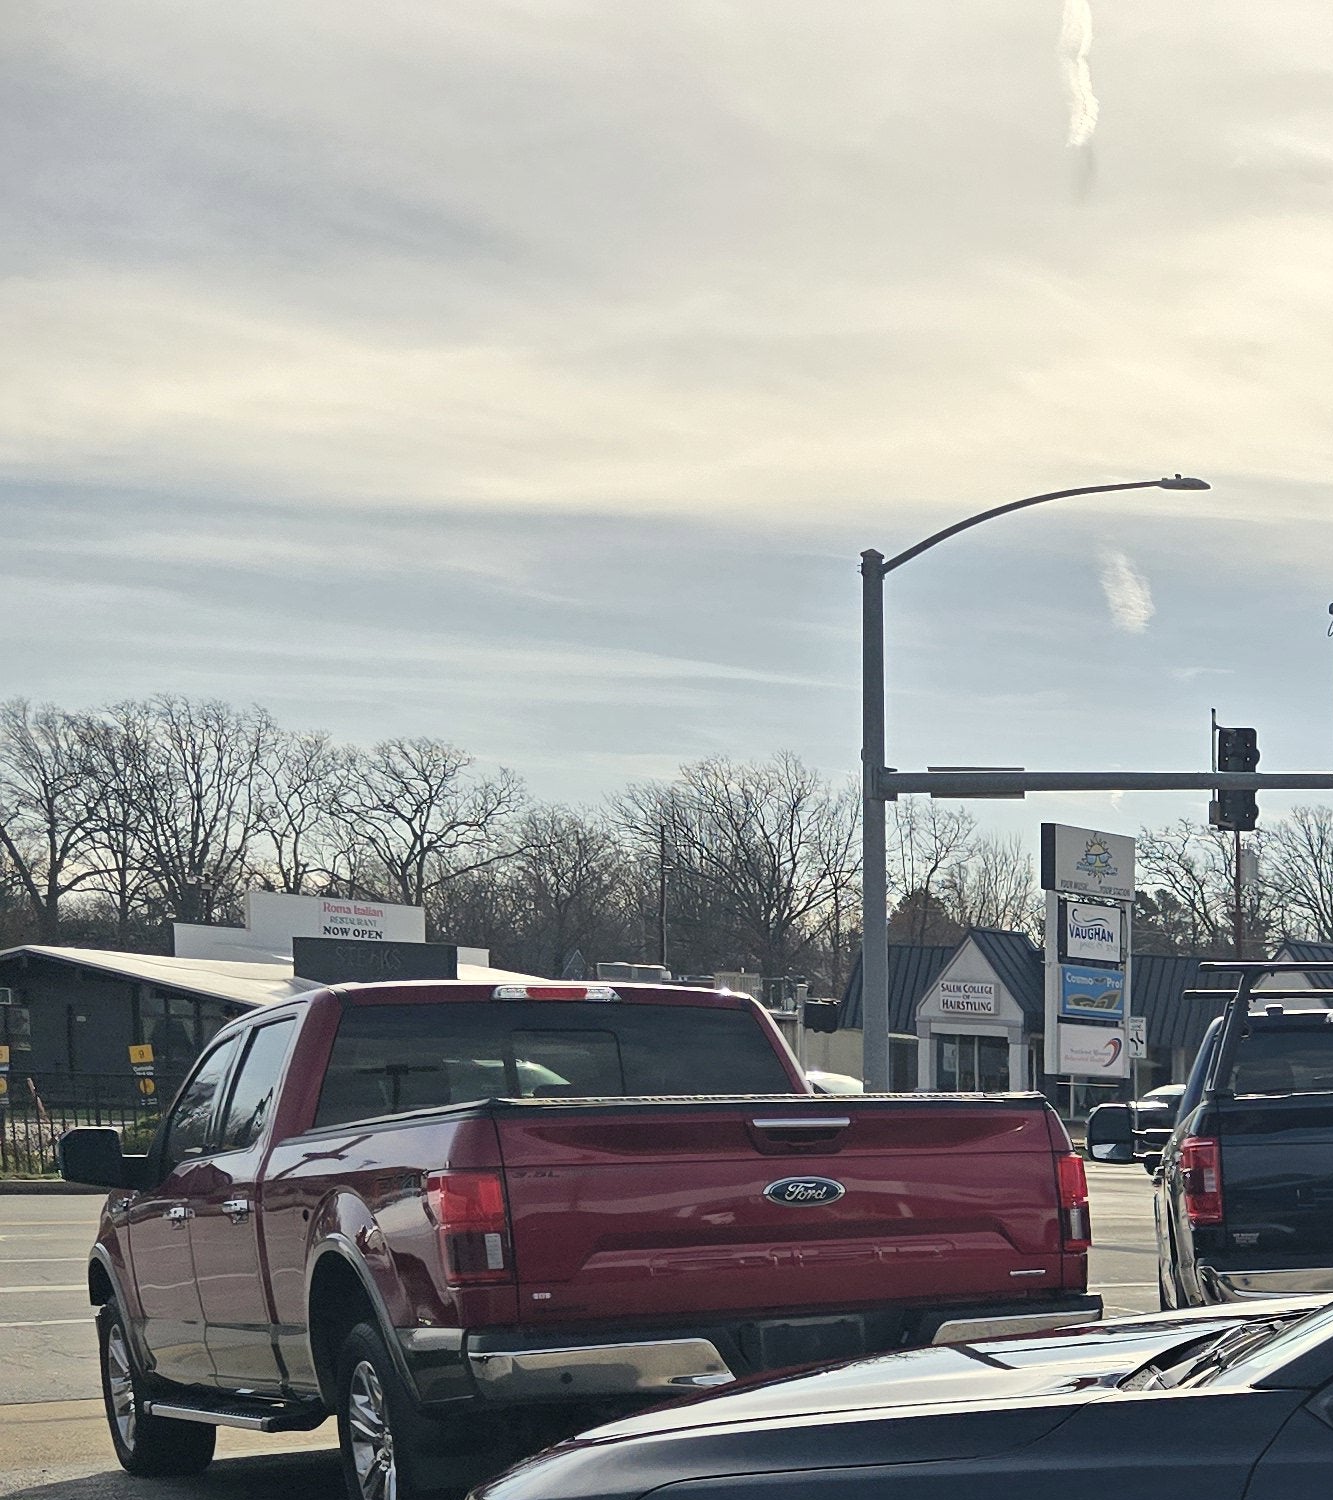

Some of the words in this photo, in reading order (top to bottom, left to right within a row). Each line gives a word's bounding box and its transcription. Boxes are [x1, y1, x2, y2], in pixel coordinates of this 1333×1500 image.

[323, 902, 352, 914] Roma
[354, 905, 384, 917] Italian
[329, 916, 377, 927] RESTAURANT
[323, 926, 350, 936] NOW
[353, 929, 383, 939] OPEN
[1069, 923, 1114, 943] VAUGHAN
[1106, 977, 1123, 989] Prof
[942, 998, 992, 1012] HAIRSTYLING
[784, 1182, 828, 1202] Ford
